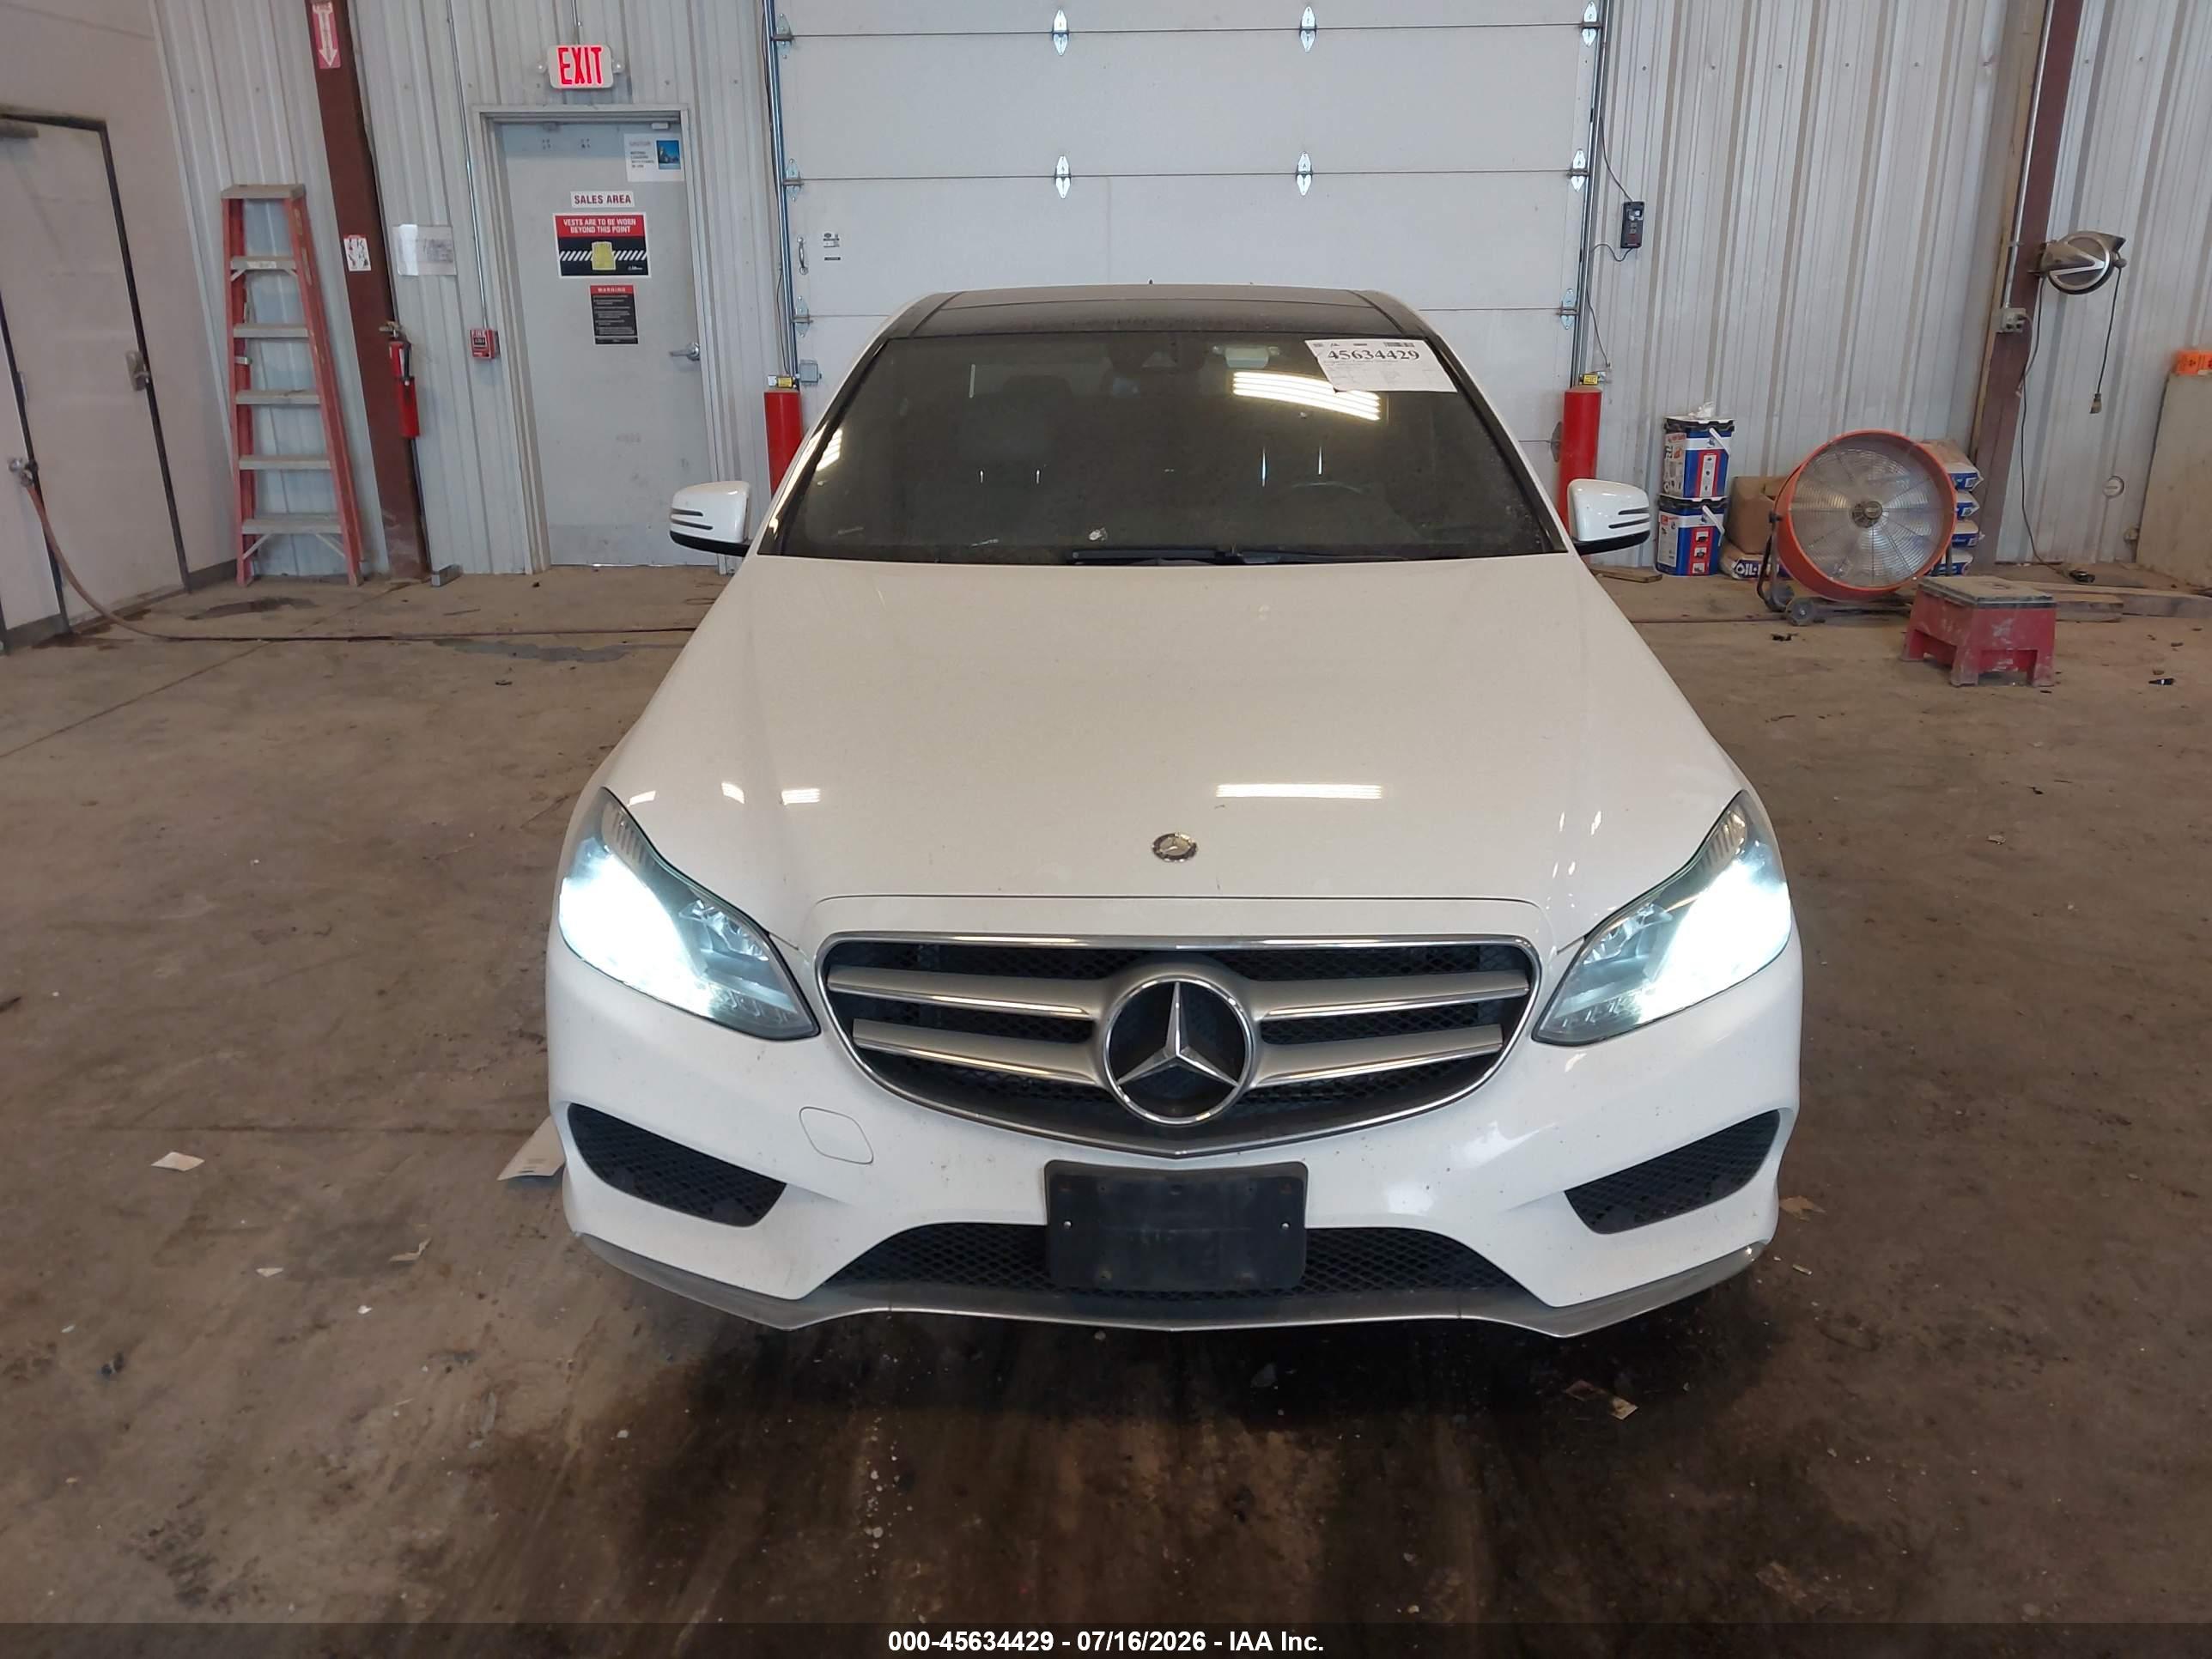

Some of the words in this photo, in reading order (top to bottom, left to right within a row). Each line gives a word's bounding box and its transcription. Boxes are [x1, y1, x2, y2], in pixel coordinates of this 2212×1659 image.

[557, 46, 602, 85] EXIT
[574, 195, 603, 204] SALES
[606, 195, 631, 204] AREA
[1328, 349, 1420, 360] 45634429
